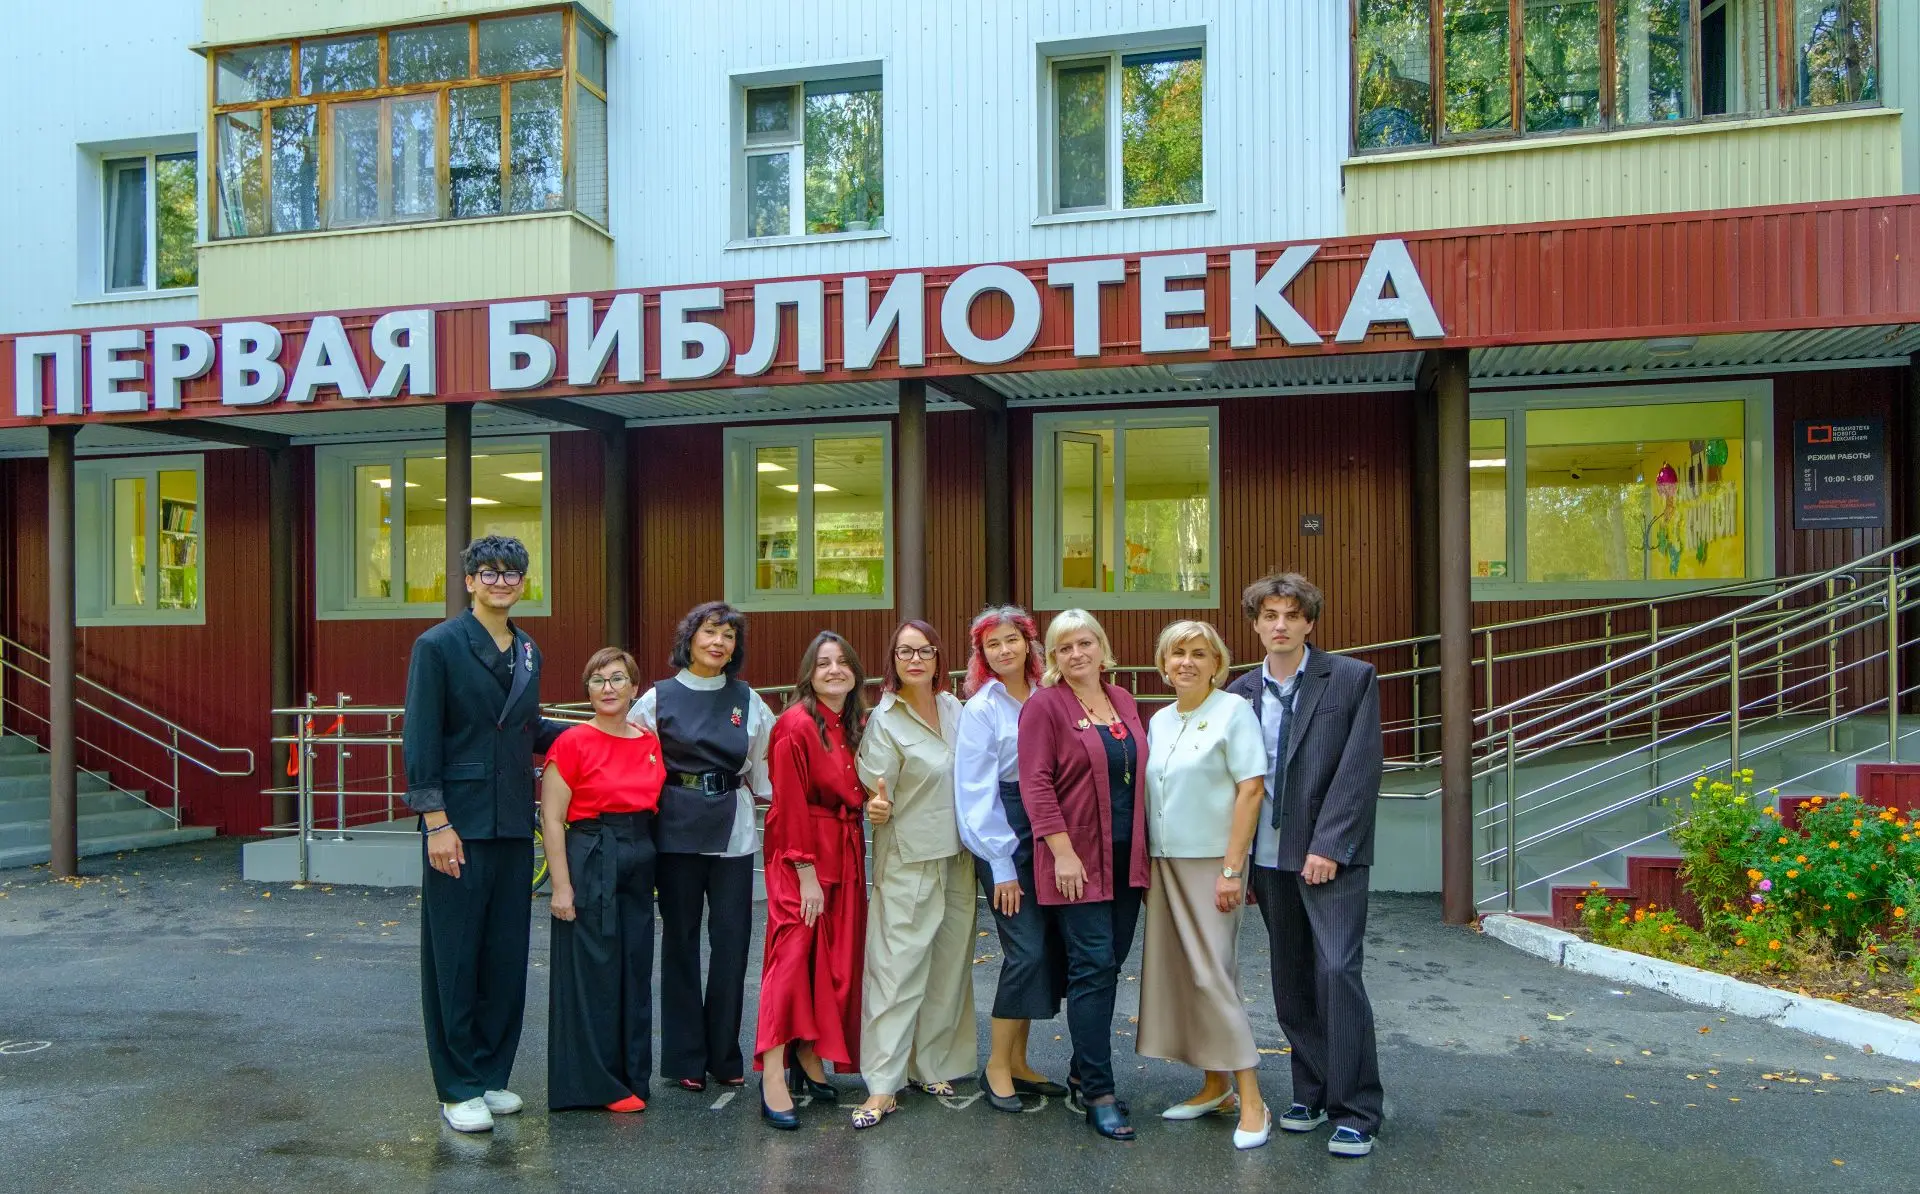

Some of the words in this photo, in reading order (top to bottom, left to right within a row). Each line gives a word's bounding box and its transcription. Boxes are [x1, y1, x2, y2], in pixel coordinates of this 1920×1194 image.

[15, 309, 436, 417] ПЕРВАЯ
[488, 239, 1446, 391] БИБЛИОТЕКА
[1837, 452, 1871, 460] РАБОТЫ
[1823, 475, 1845, 483] 10:00
[1852, 474, 1874, 482] 18:00
